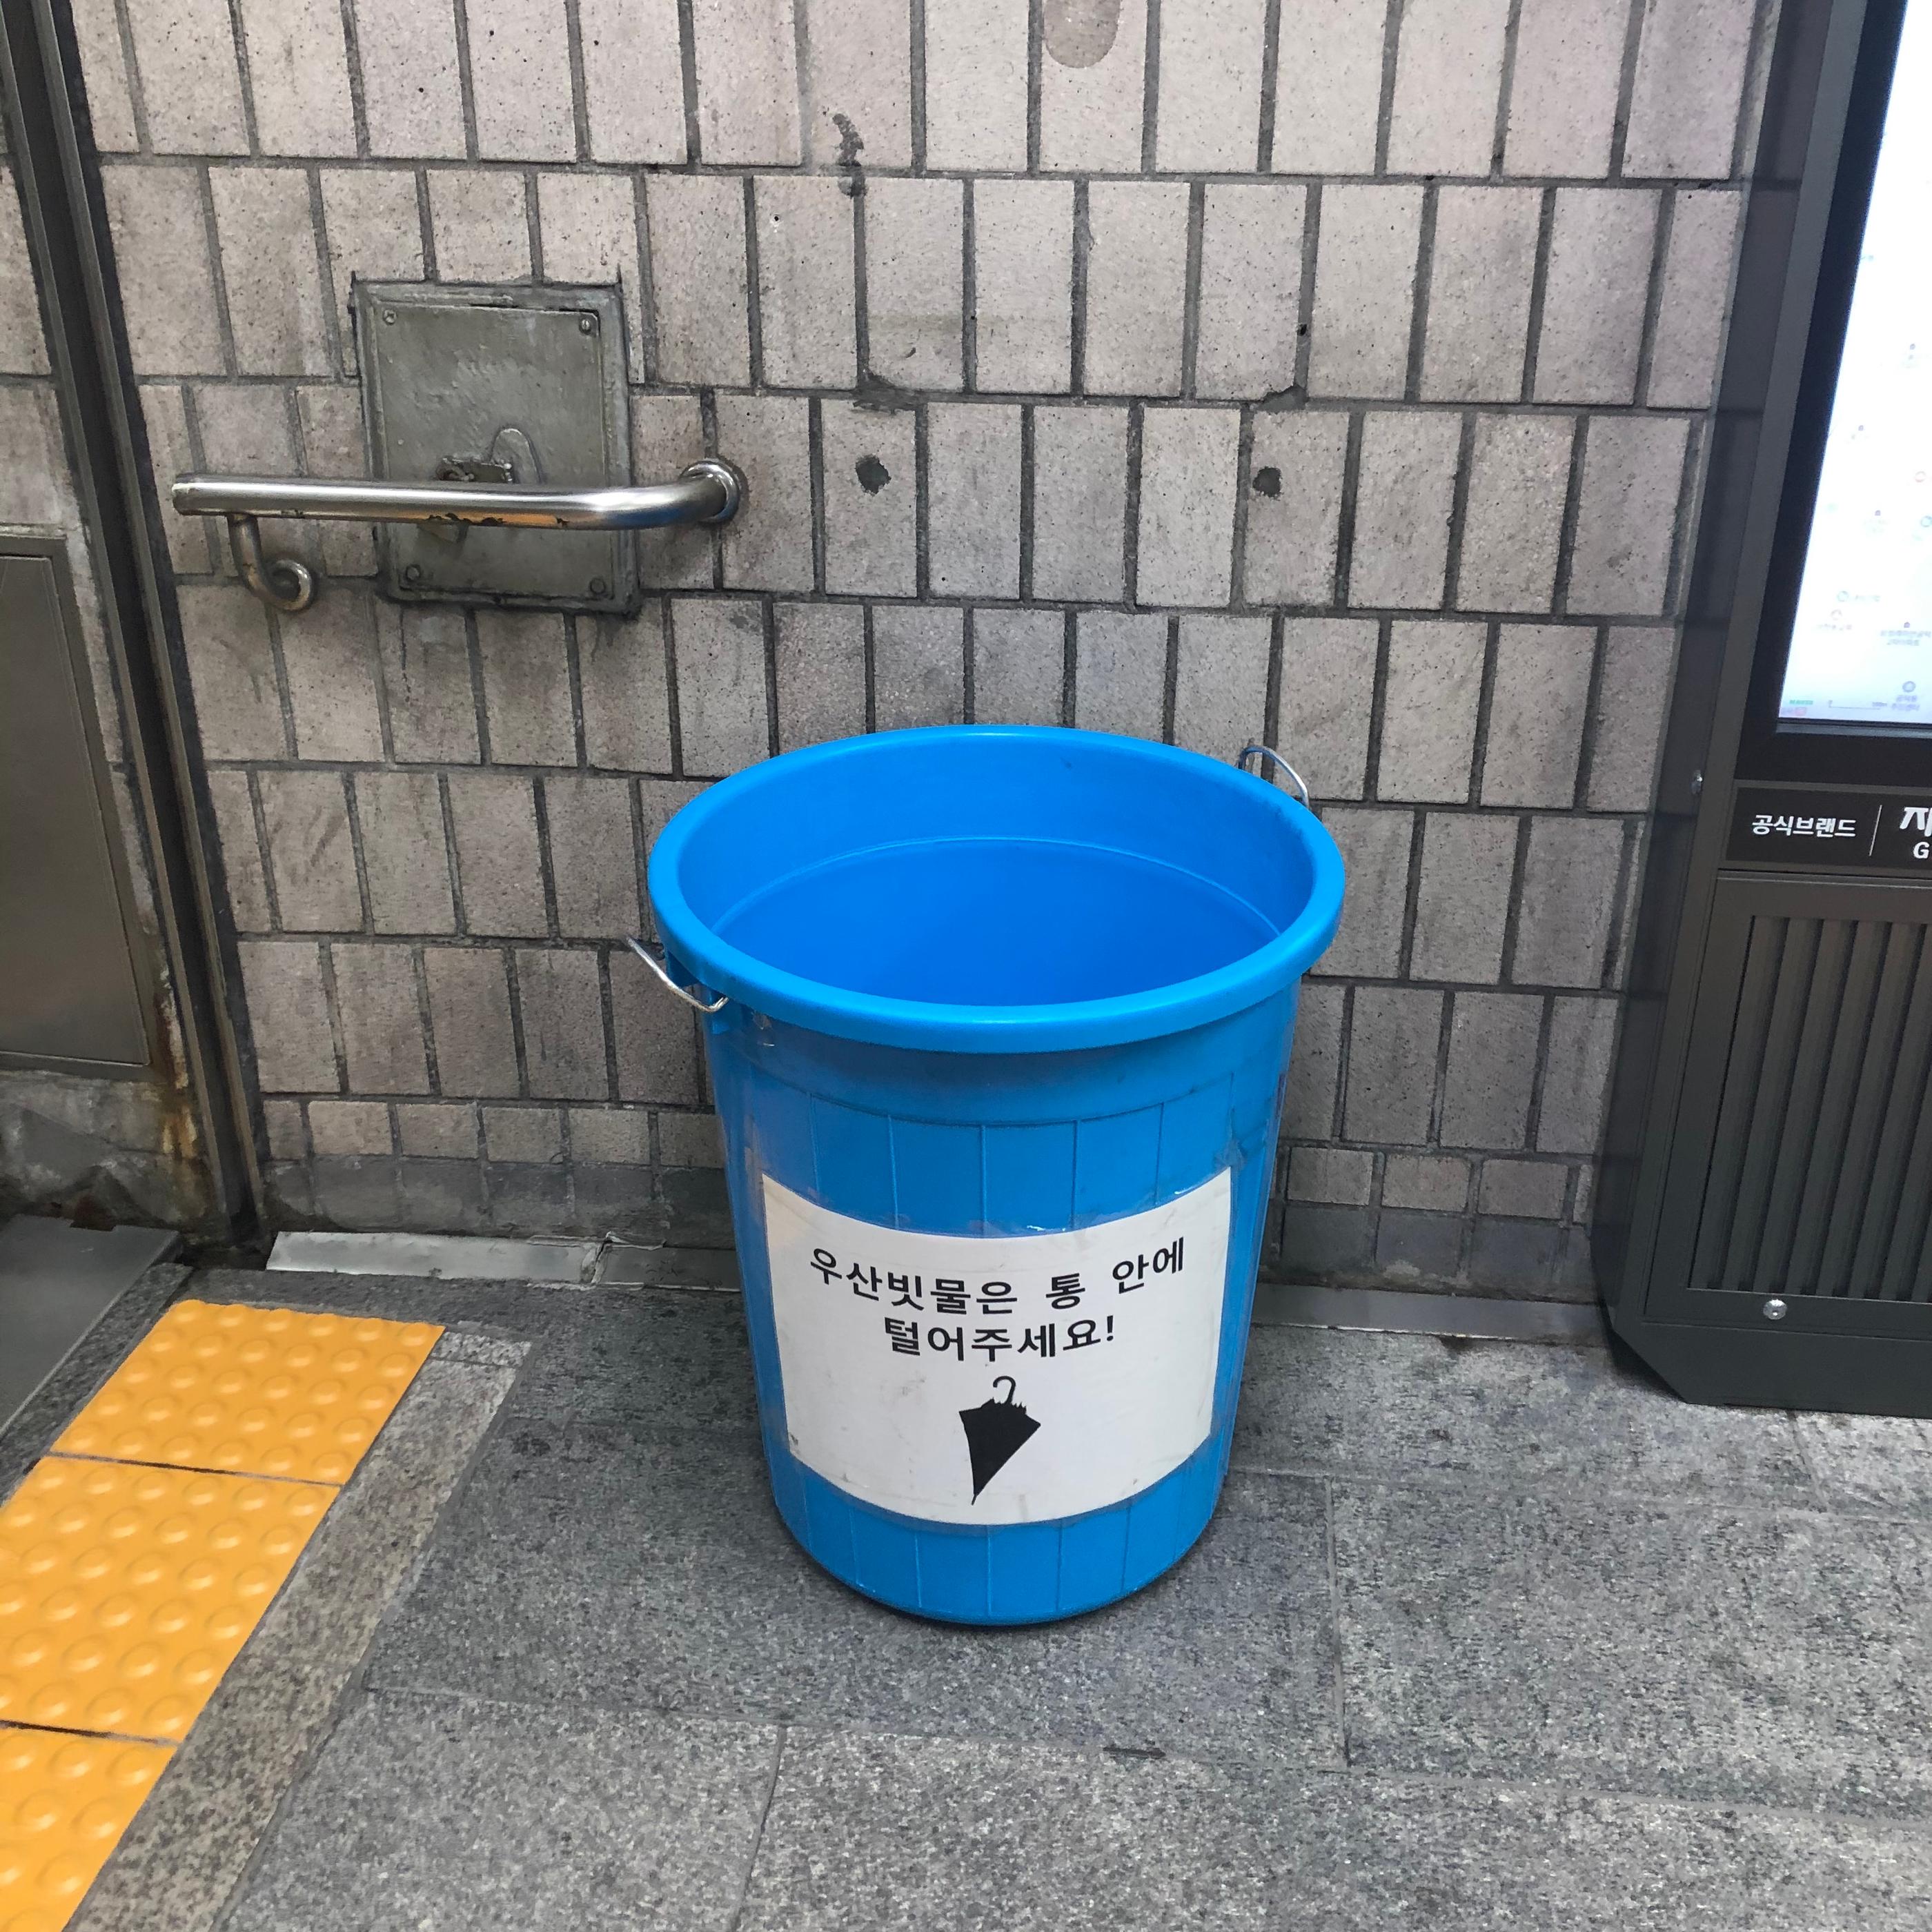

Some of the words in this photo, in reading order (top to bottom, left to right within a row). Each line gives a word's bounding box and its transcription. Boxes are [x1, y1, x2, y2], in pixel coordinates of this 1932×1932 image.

[1751, 814, 1857, 838] 공식브랜드
[809, 1248, 1018, 1315] 우산빗물은
[1045, 1272, 1086, 1310] 통
[1112, 1236, 1185, 1294] 안에
[883, 1315, 1114, 1362] 털어주세요!
